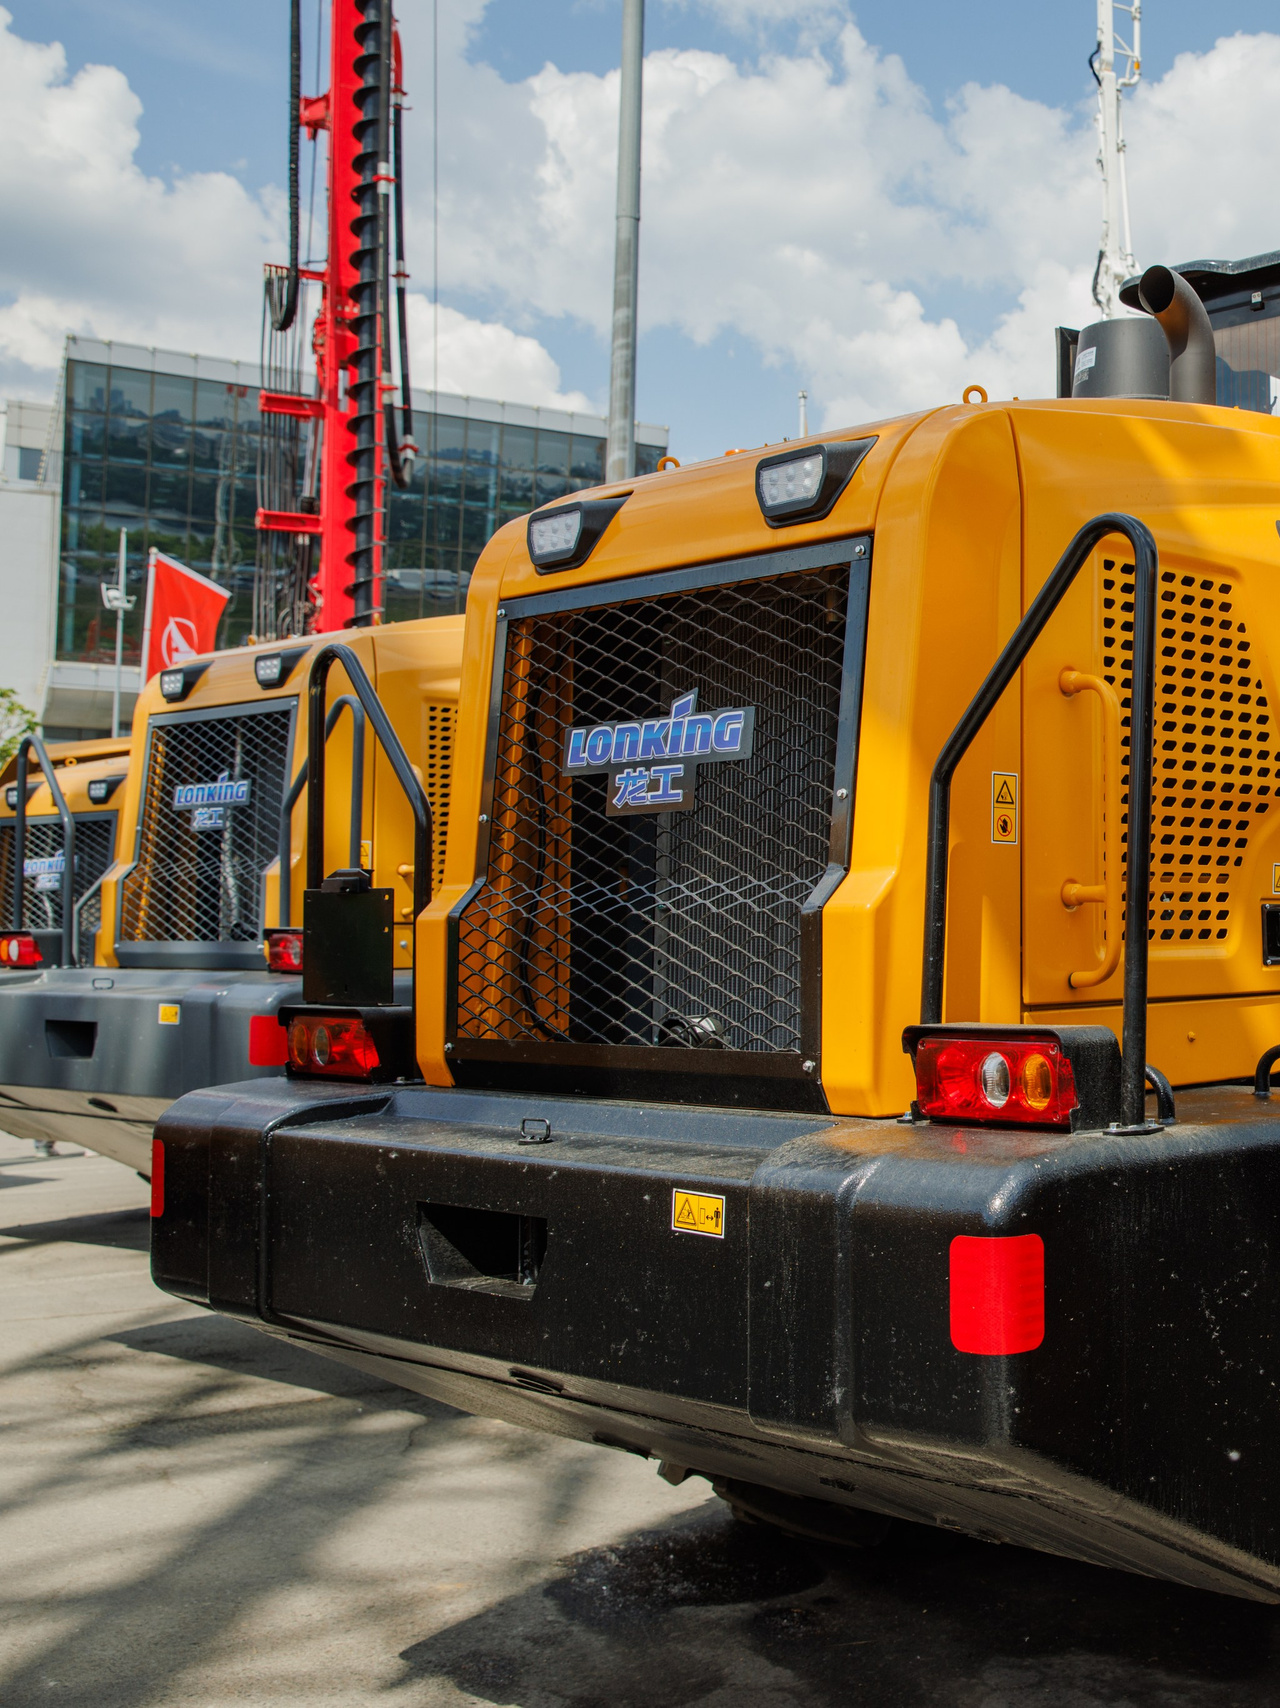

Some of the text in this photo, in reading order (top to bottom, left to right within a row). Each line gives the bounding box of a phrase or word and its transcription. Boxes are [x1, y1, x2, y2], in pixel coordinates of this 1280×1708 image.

[567, 693, 745, 767] LONKING
[175, 771, 249, 806] LONKING
[612, 763, 685, 808] 龙工
